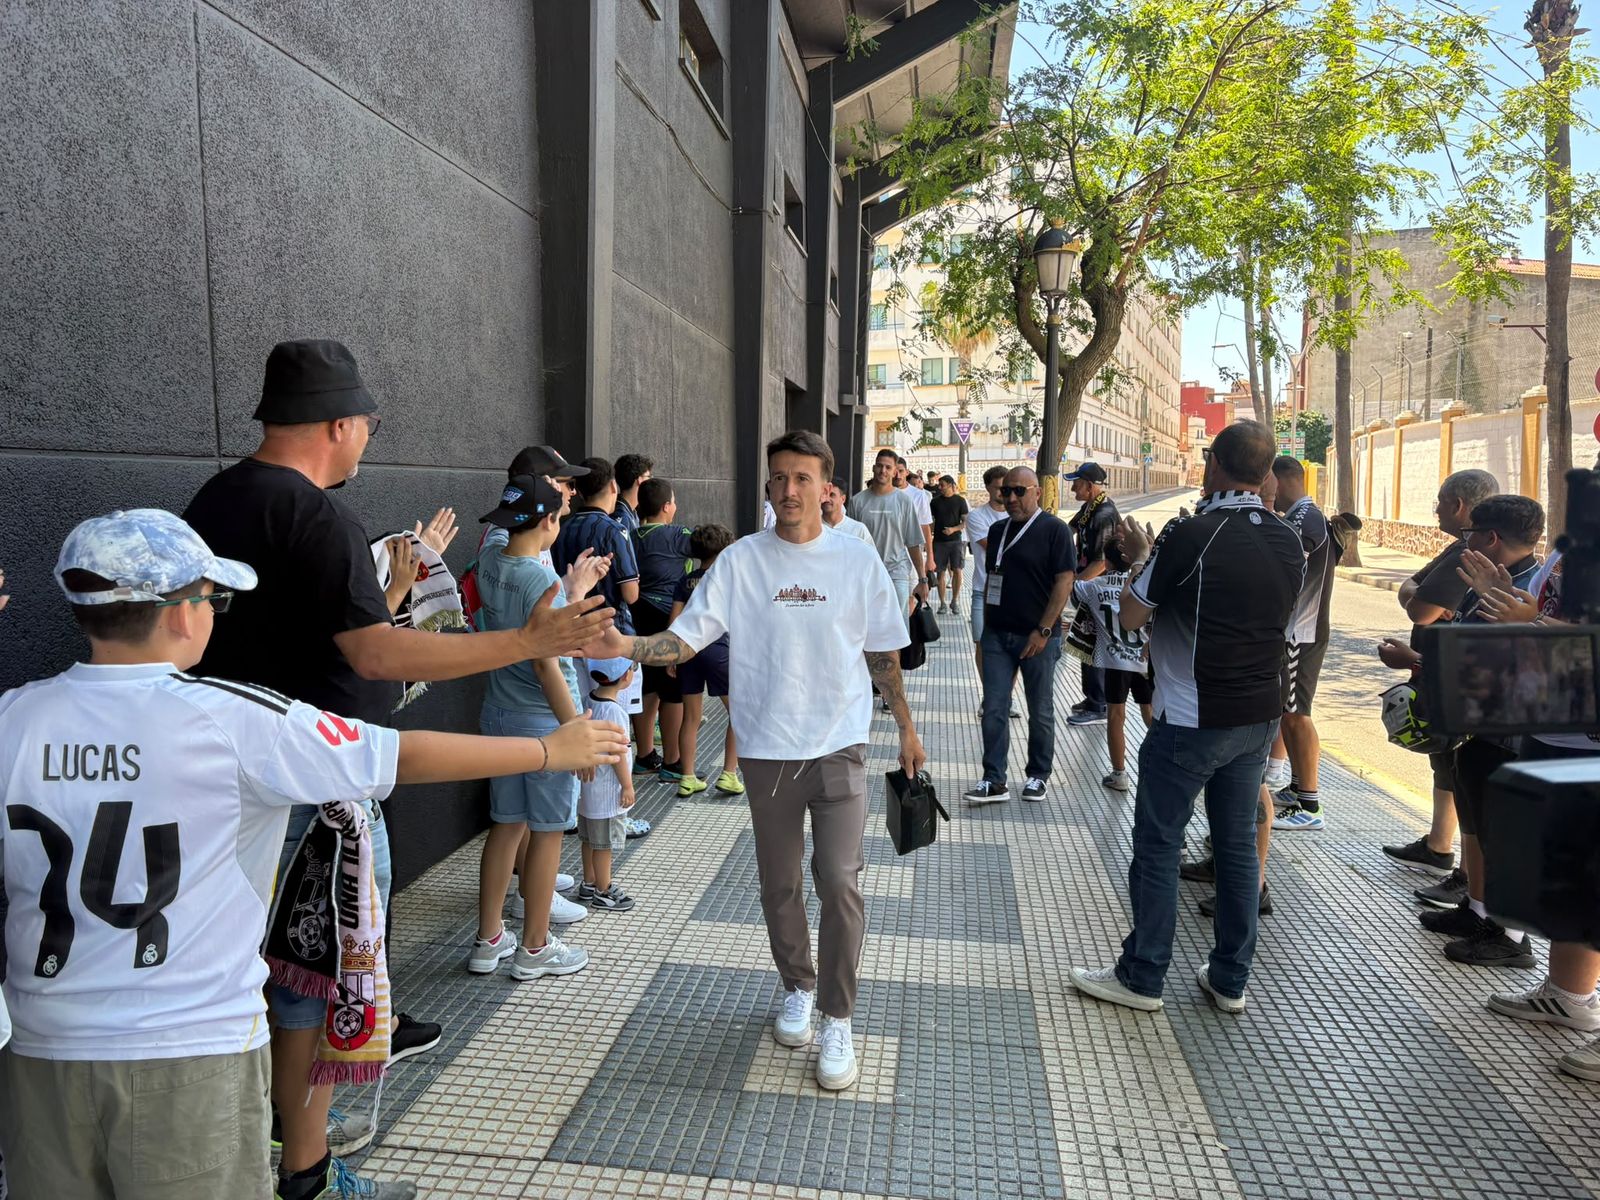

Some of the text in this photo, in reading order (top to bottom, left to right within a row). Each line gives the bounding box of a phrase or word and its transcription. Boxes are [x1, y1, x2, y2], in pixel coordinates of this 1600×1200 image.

[1097, 590, 1121, 603] CRIS
[43, 744, 141, 781] LUCAS
[6, 801, 181, 979] 14
[339, 873, 360, 930] UNA
